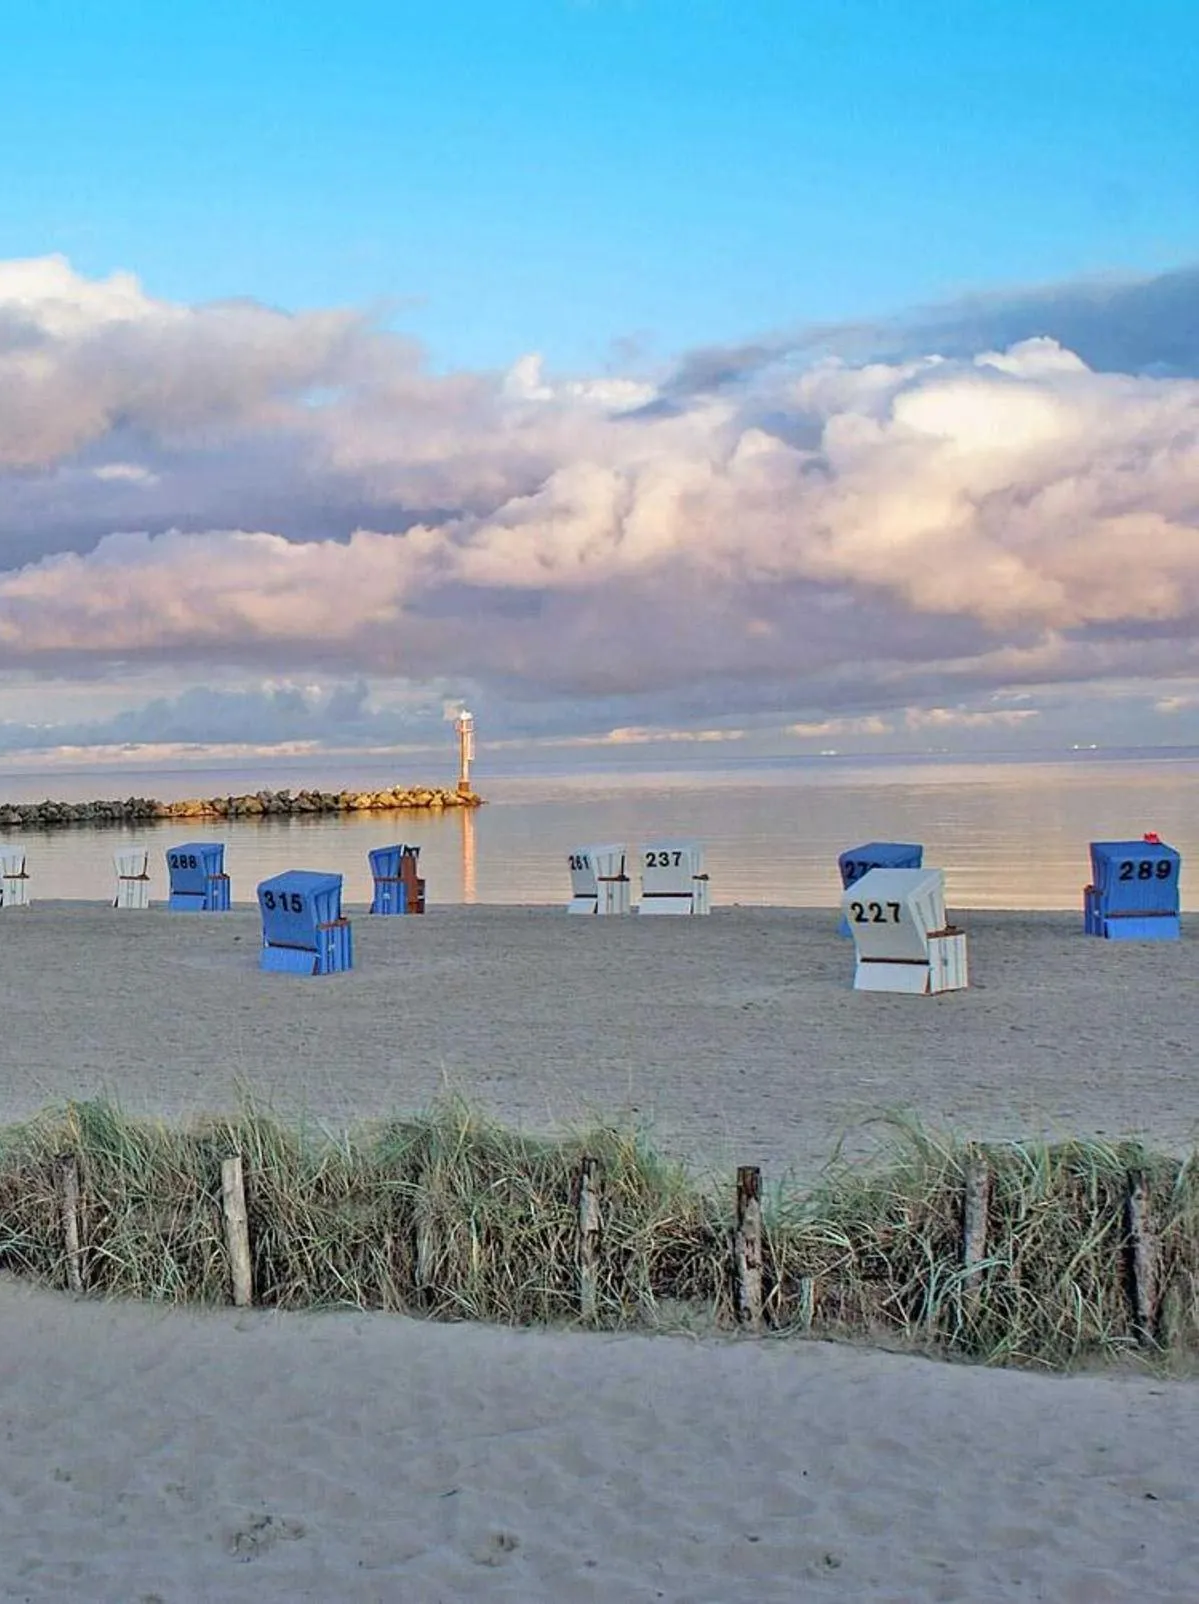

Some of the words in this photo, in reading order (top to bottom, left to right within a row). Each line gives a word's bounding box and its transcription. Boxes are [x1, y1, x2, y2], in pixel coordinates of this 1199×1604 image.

[645, 851, 682, 868] 237
[1119, 859, 1172, 881] 289
[845, 861, 882, 881] 27
[264, 889, 304, 914] 315
[850, 901, 901, 924] 227
